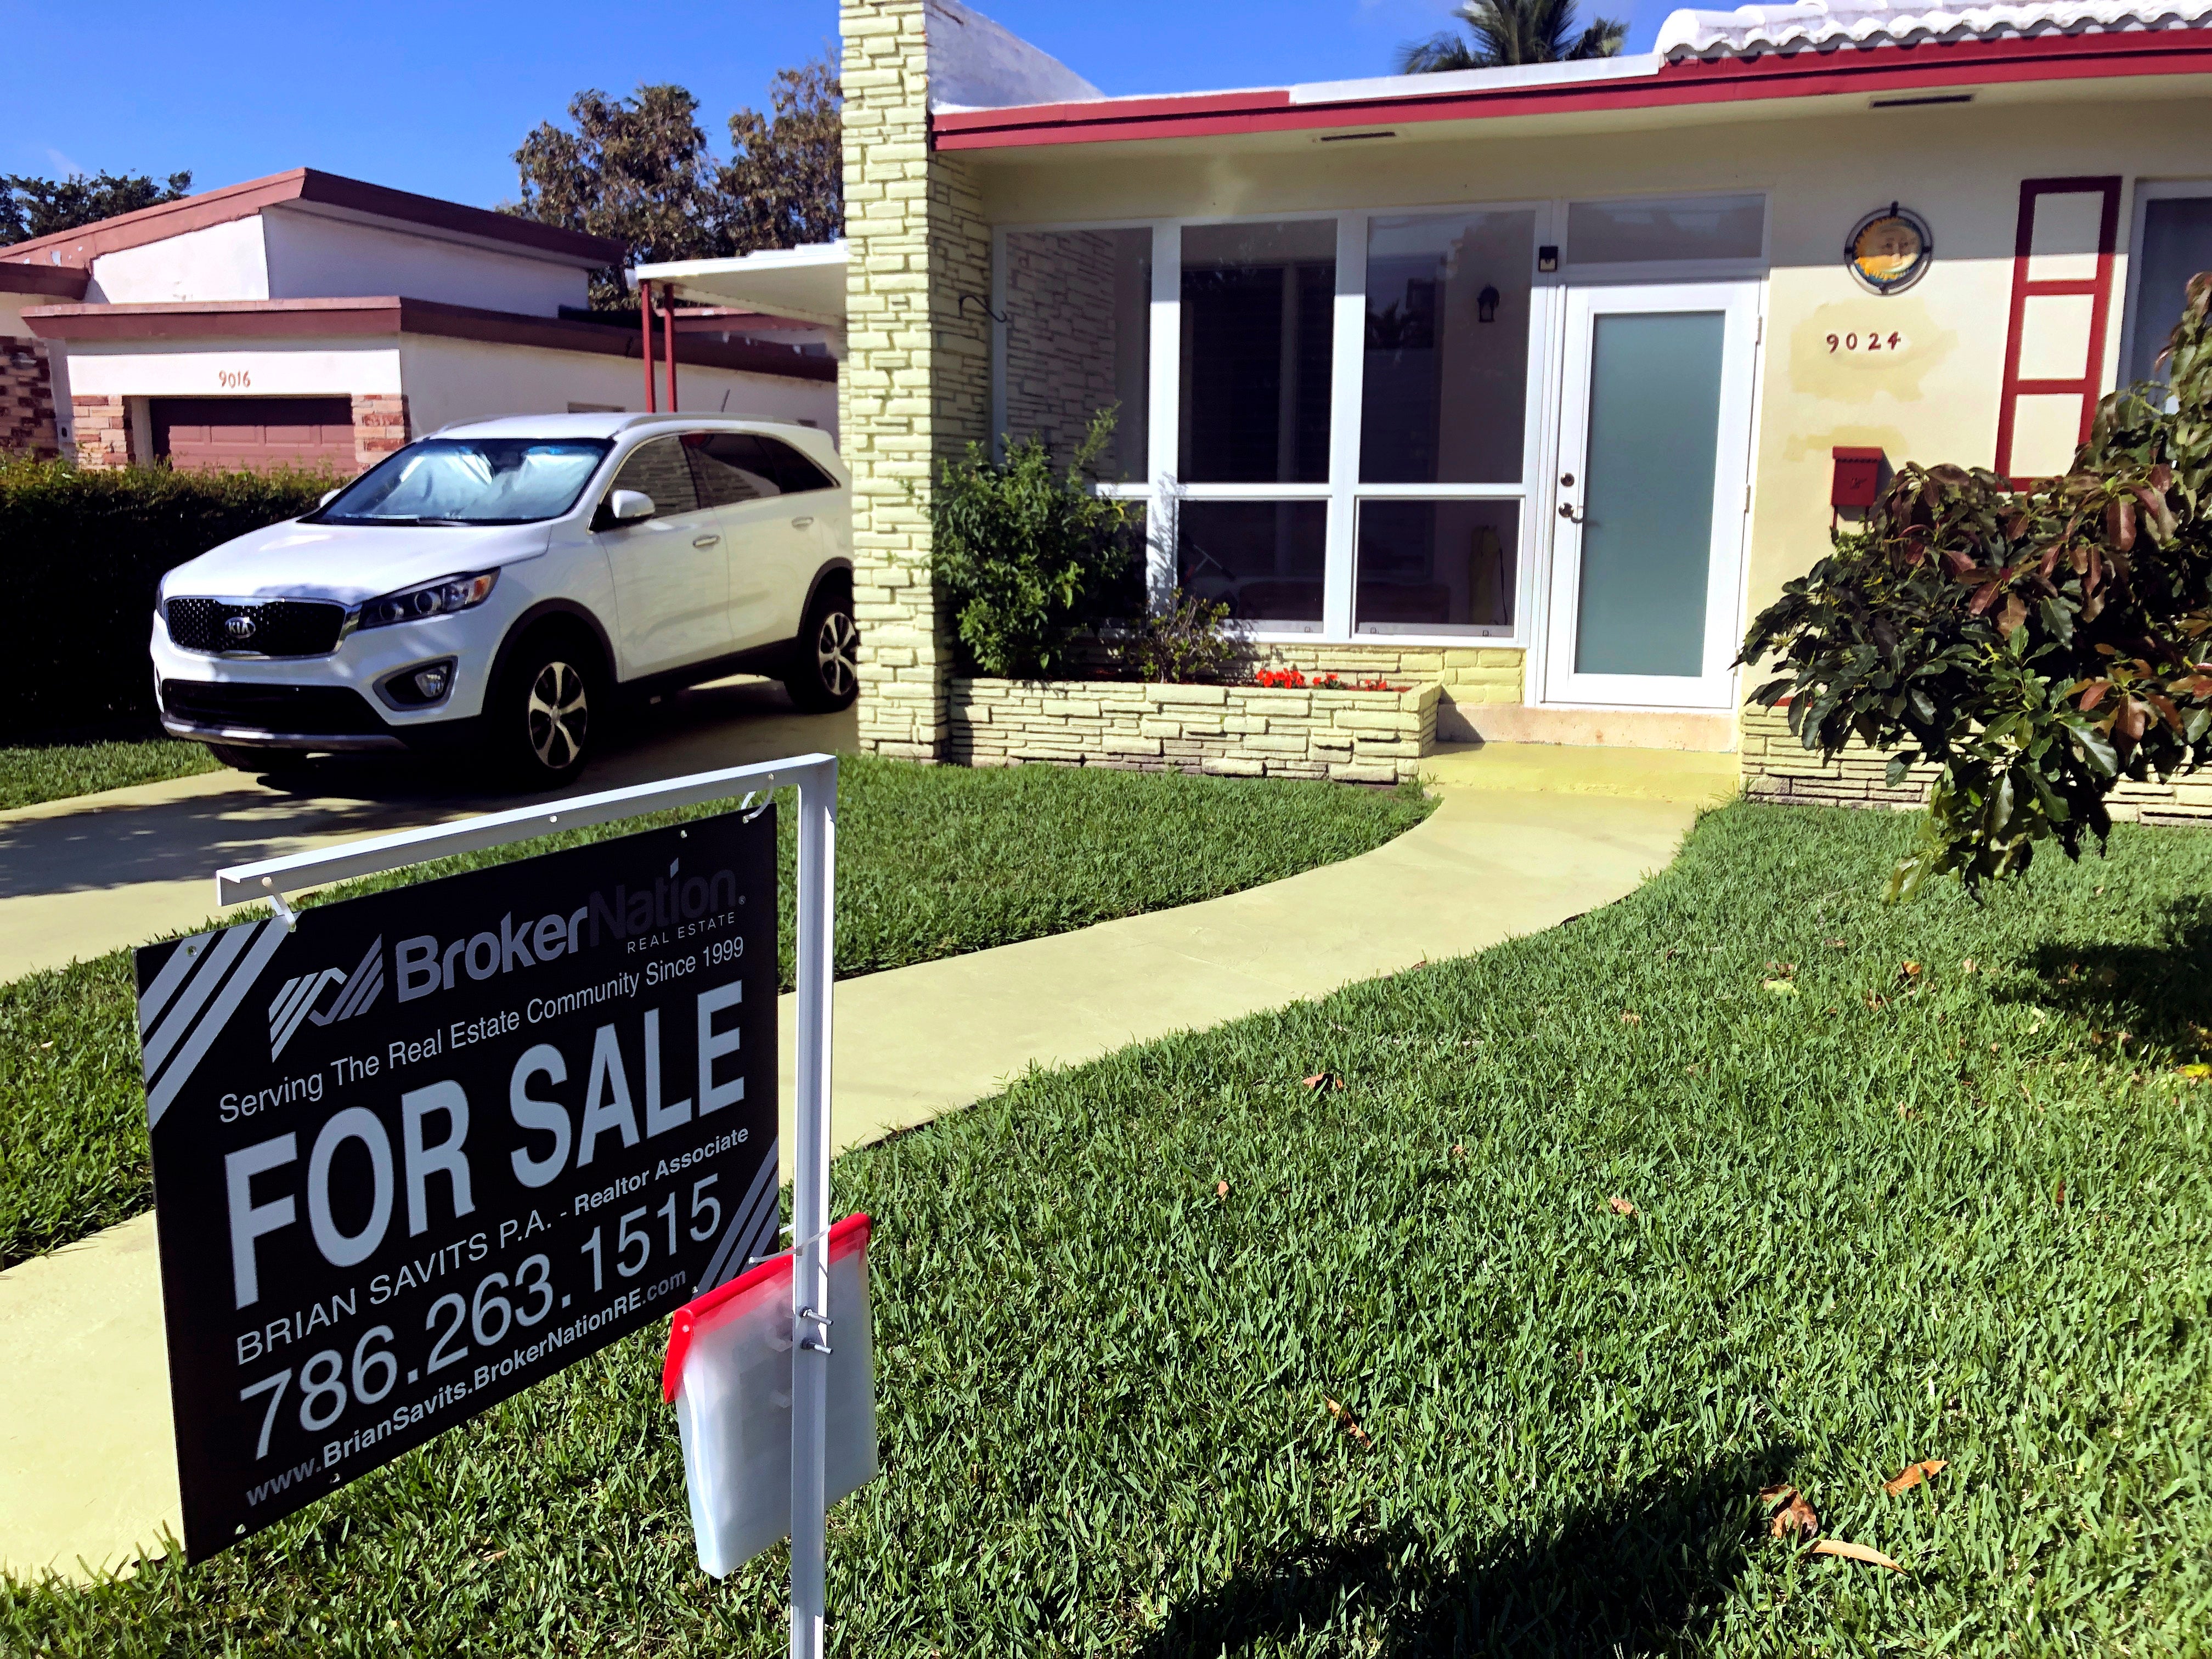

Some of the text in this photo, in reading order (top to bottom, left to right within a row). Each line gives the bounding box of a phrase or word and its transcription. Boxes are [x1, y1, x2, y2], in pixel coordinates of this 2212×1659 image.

[219, 370, 251, 388] 9016
[1826, 331, 1901, 353] 9024
[229, 621, 250, 635] KIA
[628, 912, 735, 953] REAL ESTATE
[219, 936, 743, 1123] Serving The Real Estate Community Since 1999
[224, 979, 744, 1311] FOR SALE
[236, 1288, 357, 1365] BRIAN
[370, 1233, 488, 1305] SAVITS
[499, 1209, 552, 1249] P.A.
[574, 1170, 649, 1216] Realtor
[654, 1128, 748, 1181] Associate
[240, 1173, 721, 1460] 786.263.1515
[246, 1268, 686, 1506] www.BrianSavits.BrokerNationRE.com
